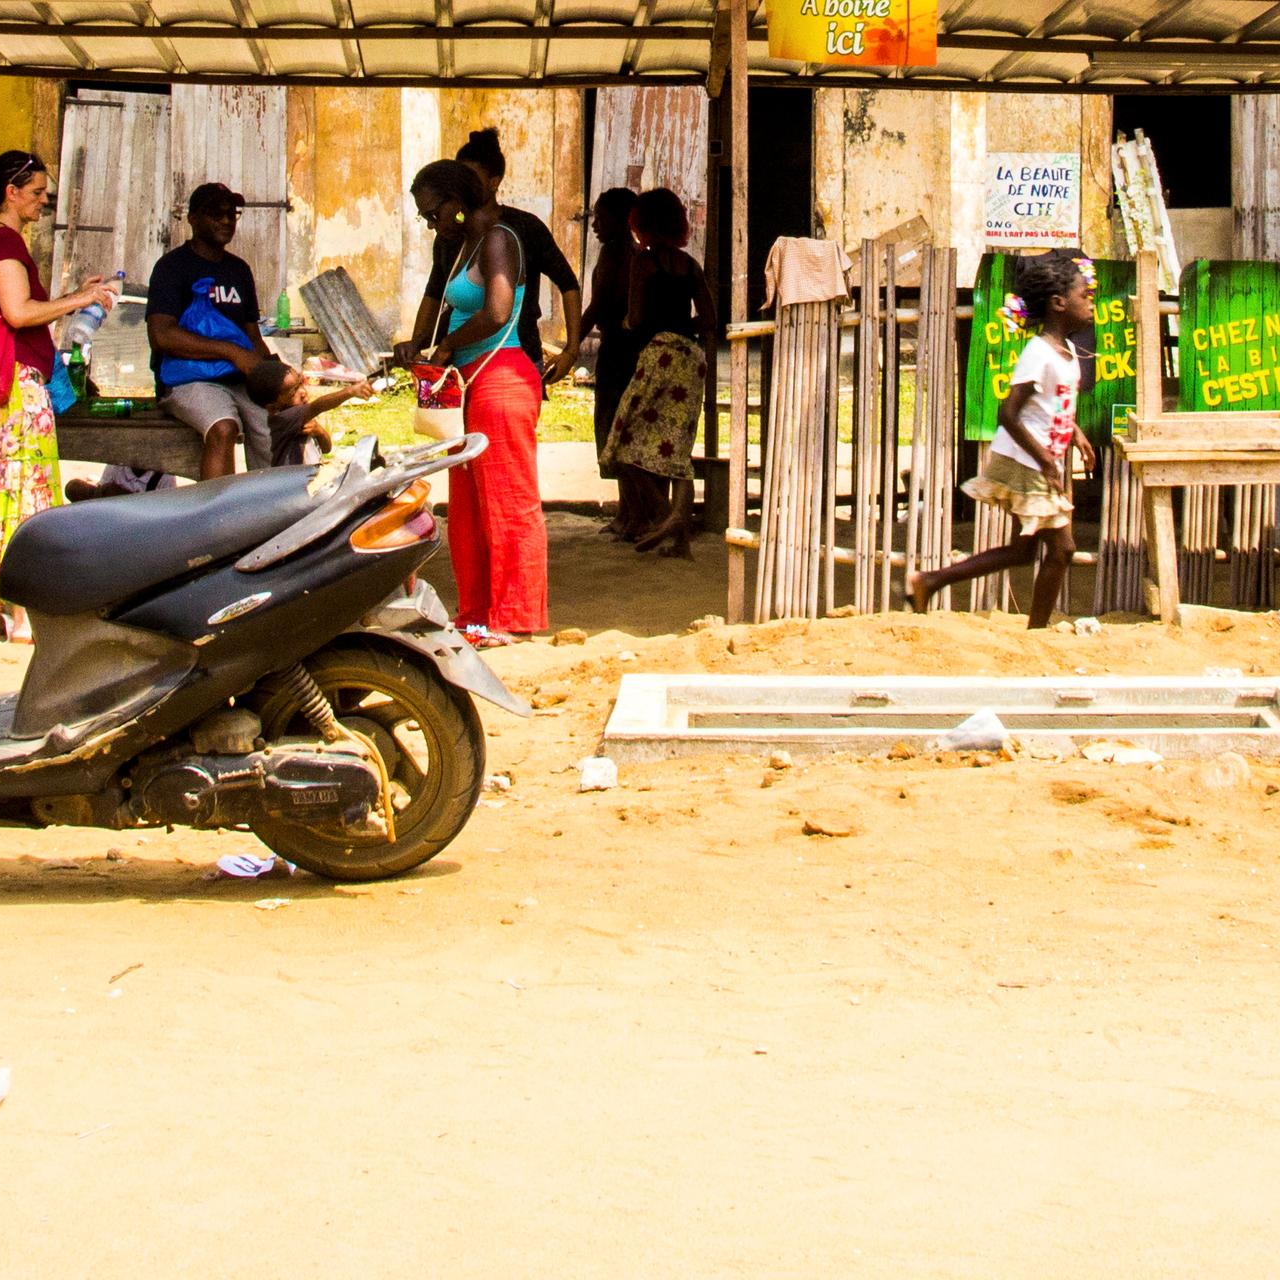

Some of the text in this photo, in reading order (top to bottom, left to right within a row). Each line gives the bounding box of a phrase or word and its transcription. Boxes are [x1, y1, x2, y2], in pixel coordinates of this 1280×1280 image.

[826, 21, 865, 56] ici
[996, 166, 1072, 181] LA BEAUTE
[1008, 184, 1070, 199] DE NOTRE
[1013, 202, 1055, 217] CITE
[1192, 318, 1259, 351] CHEZ
[1197, 355, 1231, 377] LA
[1202, 368, 1270, 406] C'EST
